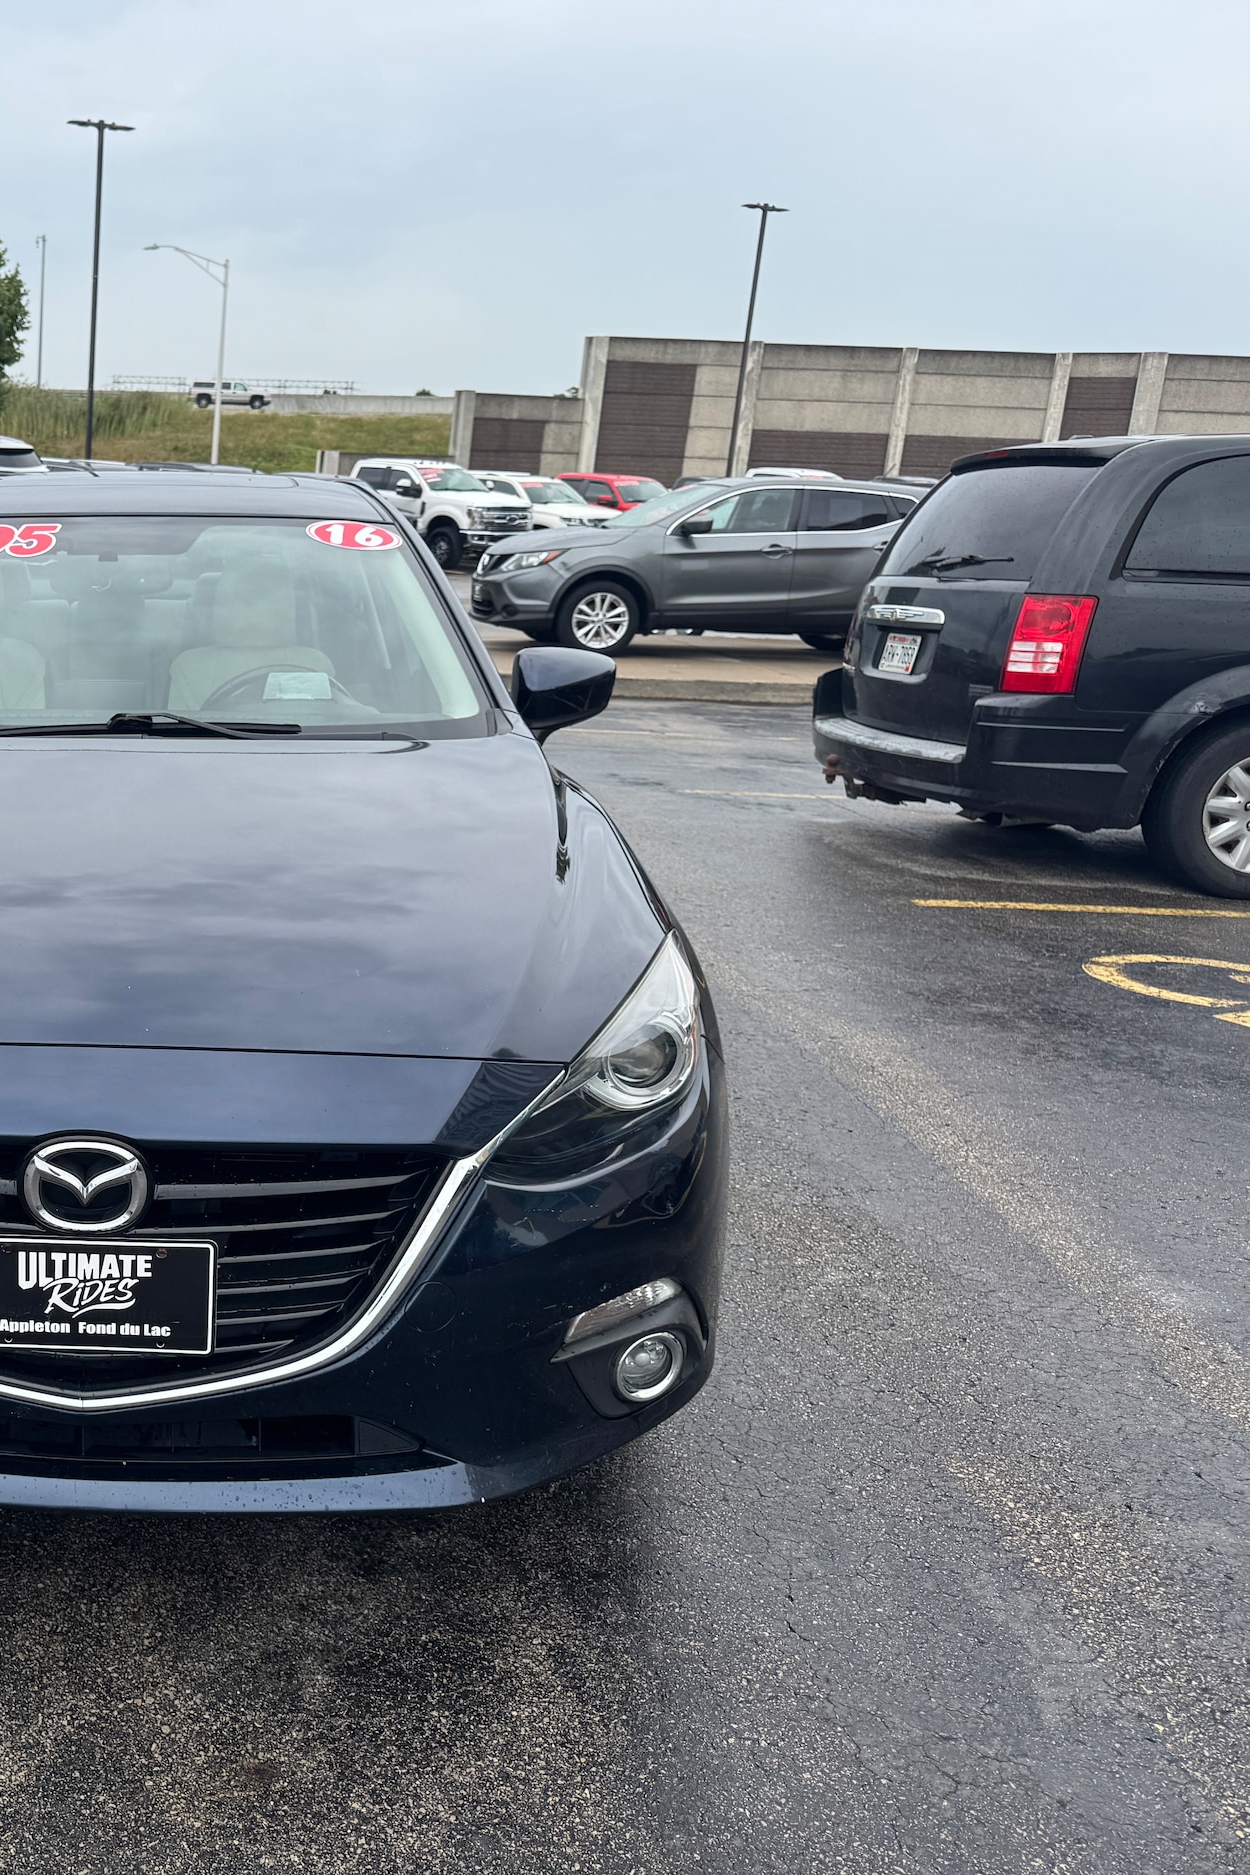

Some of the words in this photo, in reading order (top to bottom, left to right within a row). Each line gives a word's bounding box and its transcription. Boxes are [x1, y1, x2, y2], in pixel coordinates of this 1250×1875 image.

[325, 524, 384, 547] 16
[17, 1251, 153, 1290] ULTIMATE
[78, 1321, 116, 1336] Fond
[120, 1322, 140, 1336] du
[144, 1323, 171, 1337] Lac
